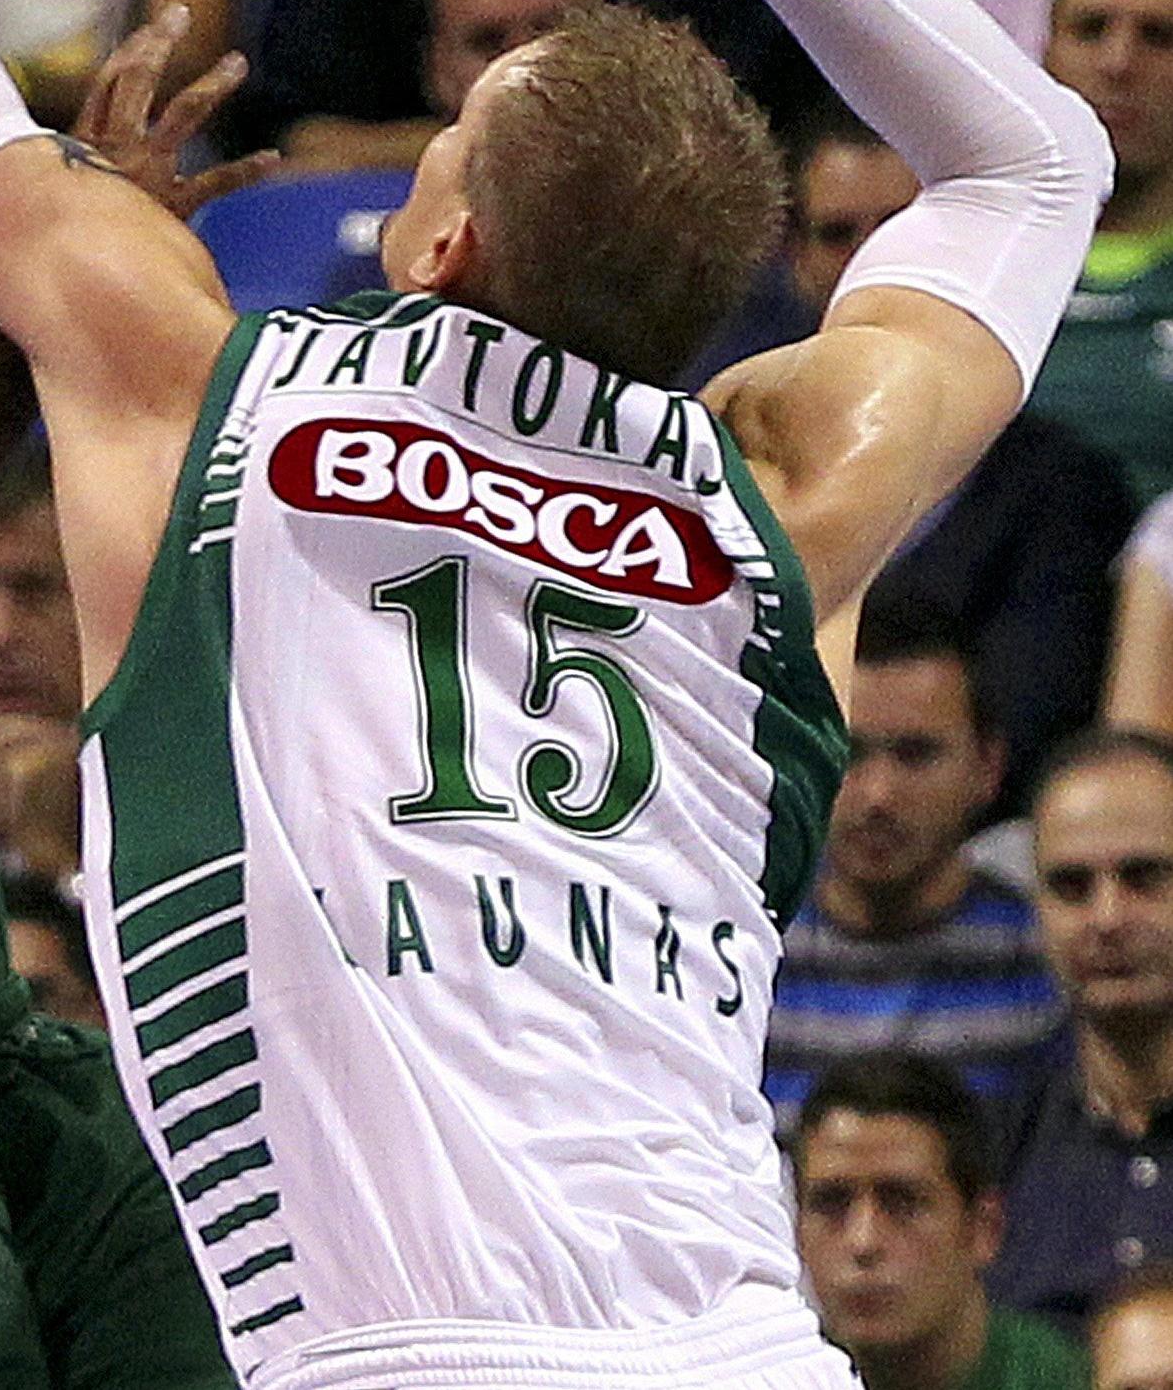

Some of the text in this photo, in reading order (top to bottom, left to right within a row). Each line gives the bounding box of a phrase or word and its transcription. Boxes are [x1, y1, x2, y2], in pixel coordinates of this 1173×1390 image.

[315, 428, 694, 589] BOSCA
[371, 555, 662, 839] 15
[313, 875, 743, 1017] AUNAS
